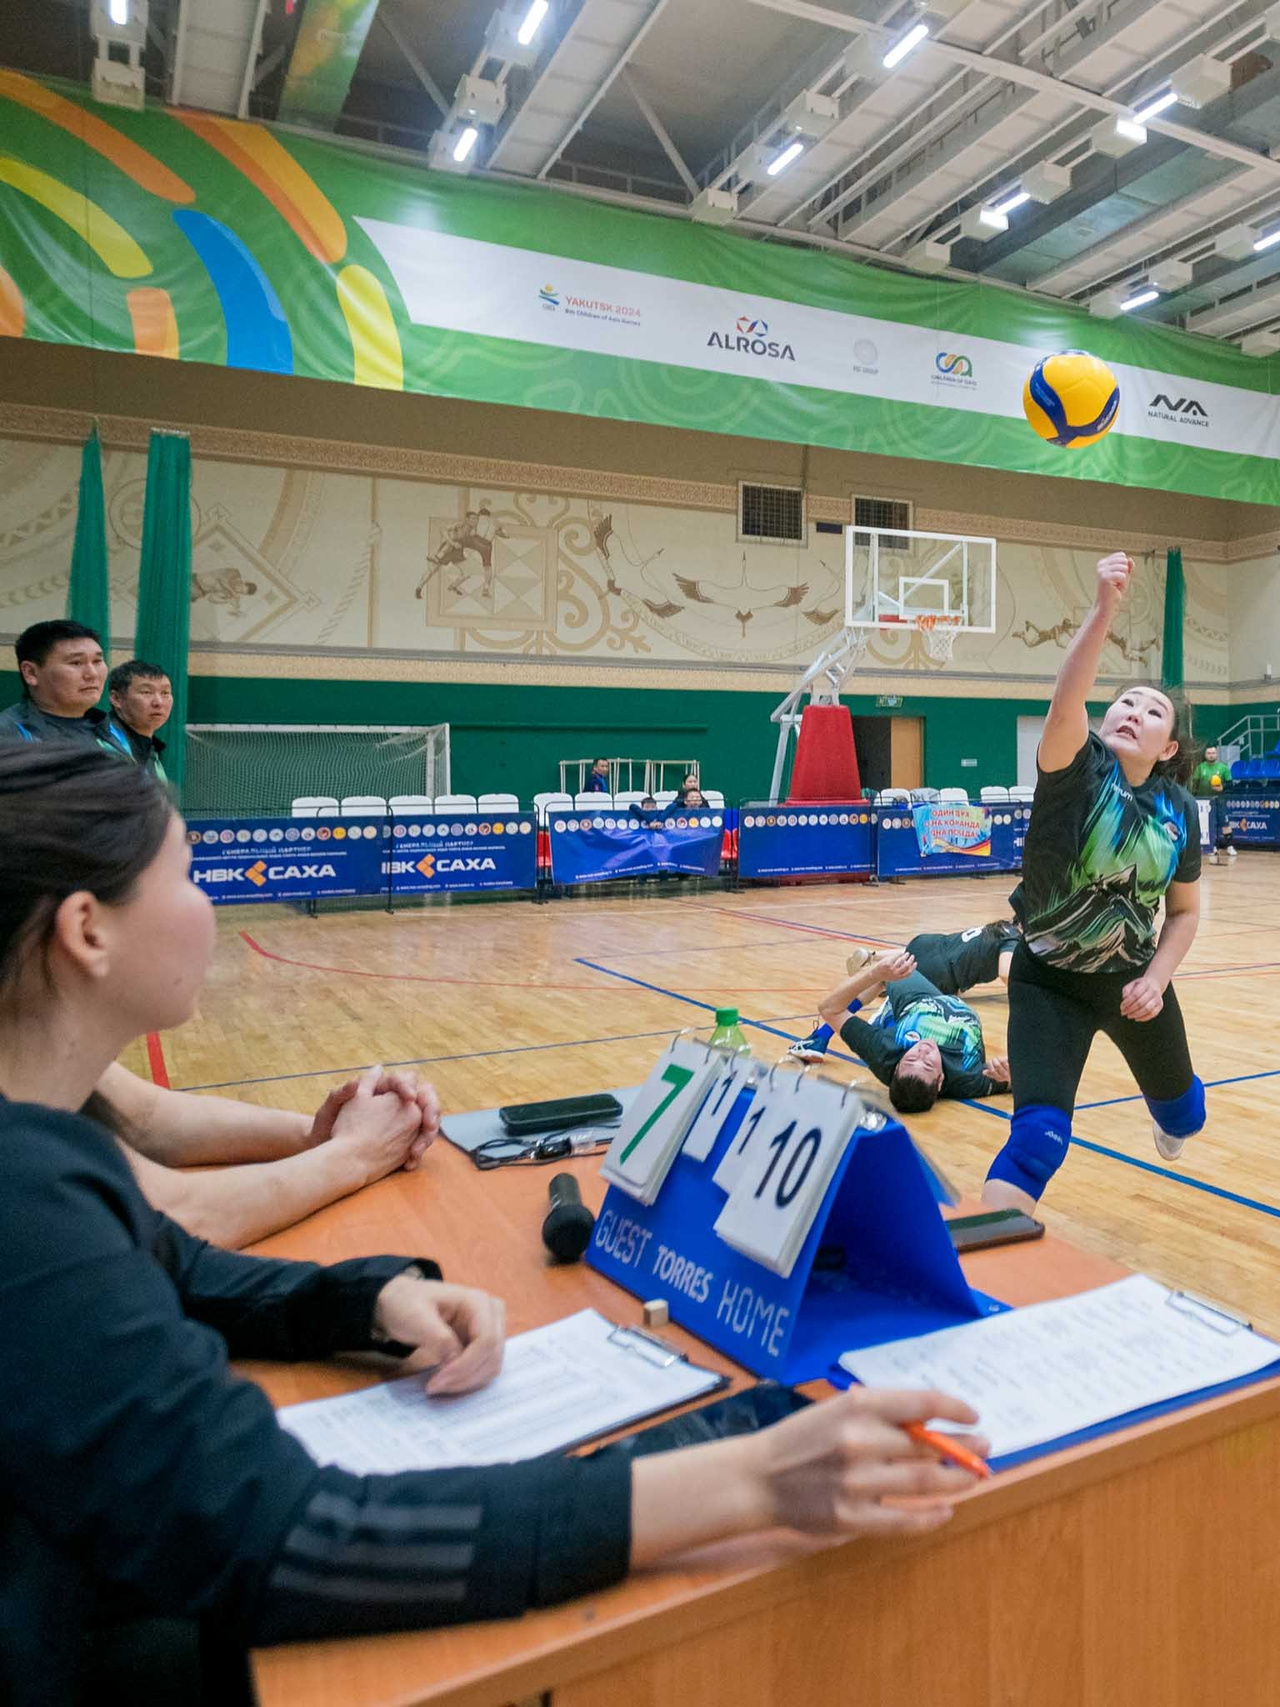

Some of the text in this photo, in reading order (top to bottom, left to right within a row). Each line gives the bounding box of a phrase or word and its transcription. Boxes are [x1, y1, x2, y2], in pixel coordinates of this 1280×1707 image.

[565, 295, 641, 318] YAKUTSK 2024
[707, 332, 796, 362] ALROSA
[1148, 411, 1209, 428] NATURAL ADVANCE
[193, 864, 337, 884] НВК САХА
[436, 857, 496, 873] САХА
[619, 1064, 695, 1166] 7
[754, 1120, 823, 1209] 10
[594, 1208, 790, 1357] GUEST TORRES HOME
